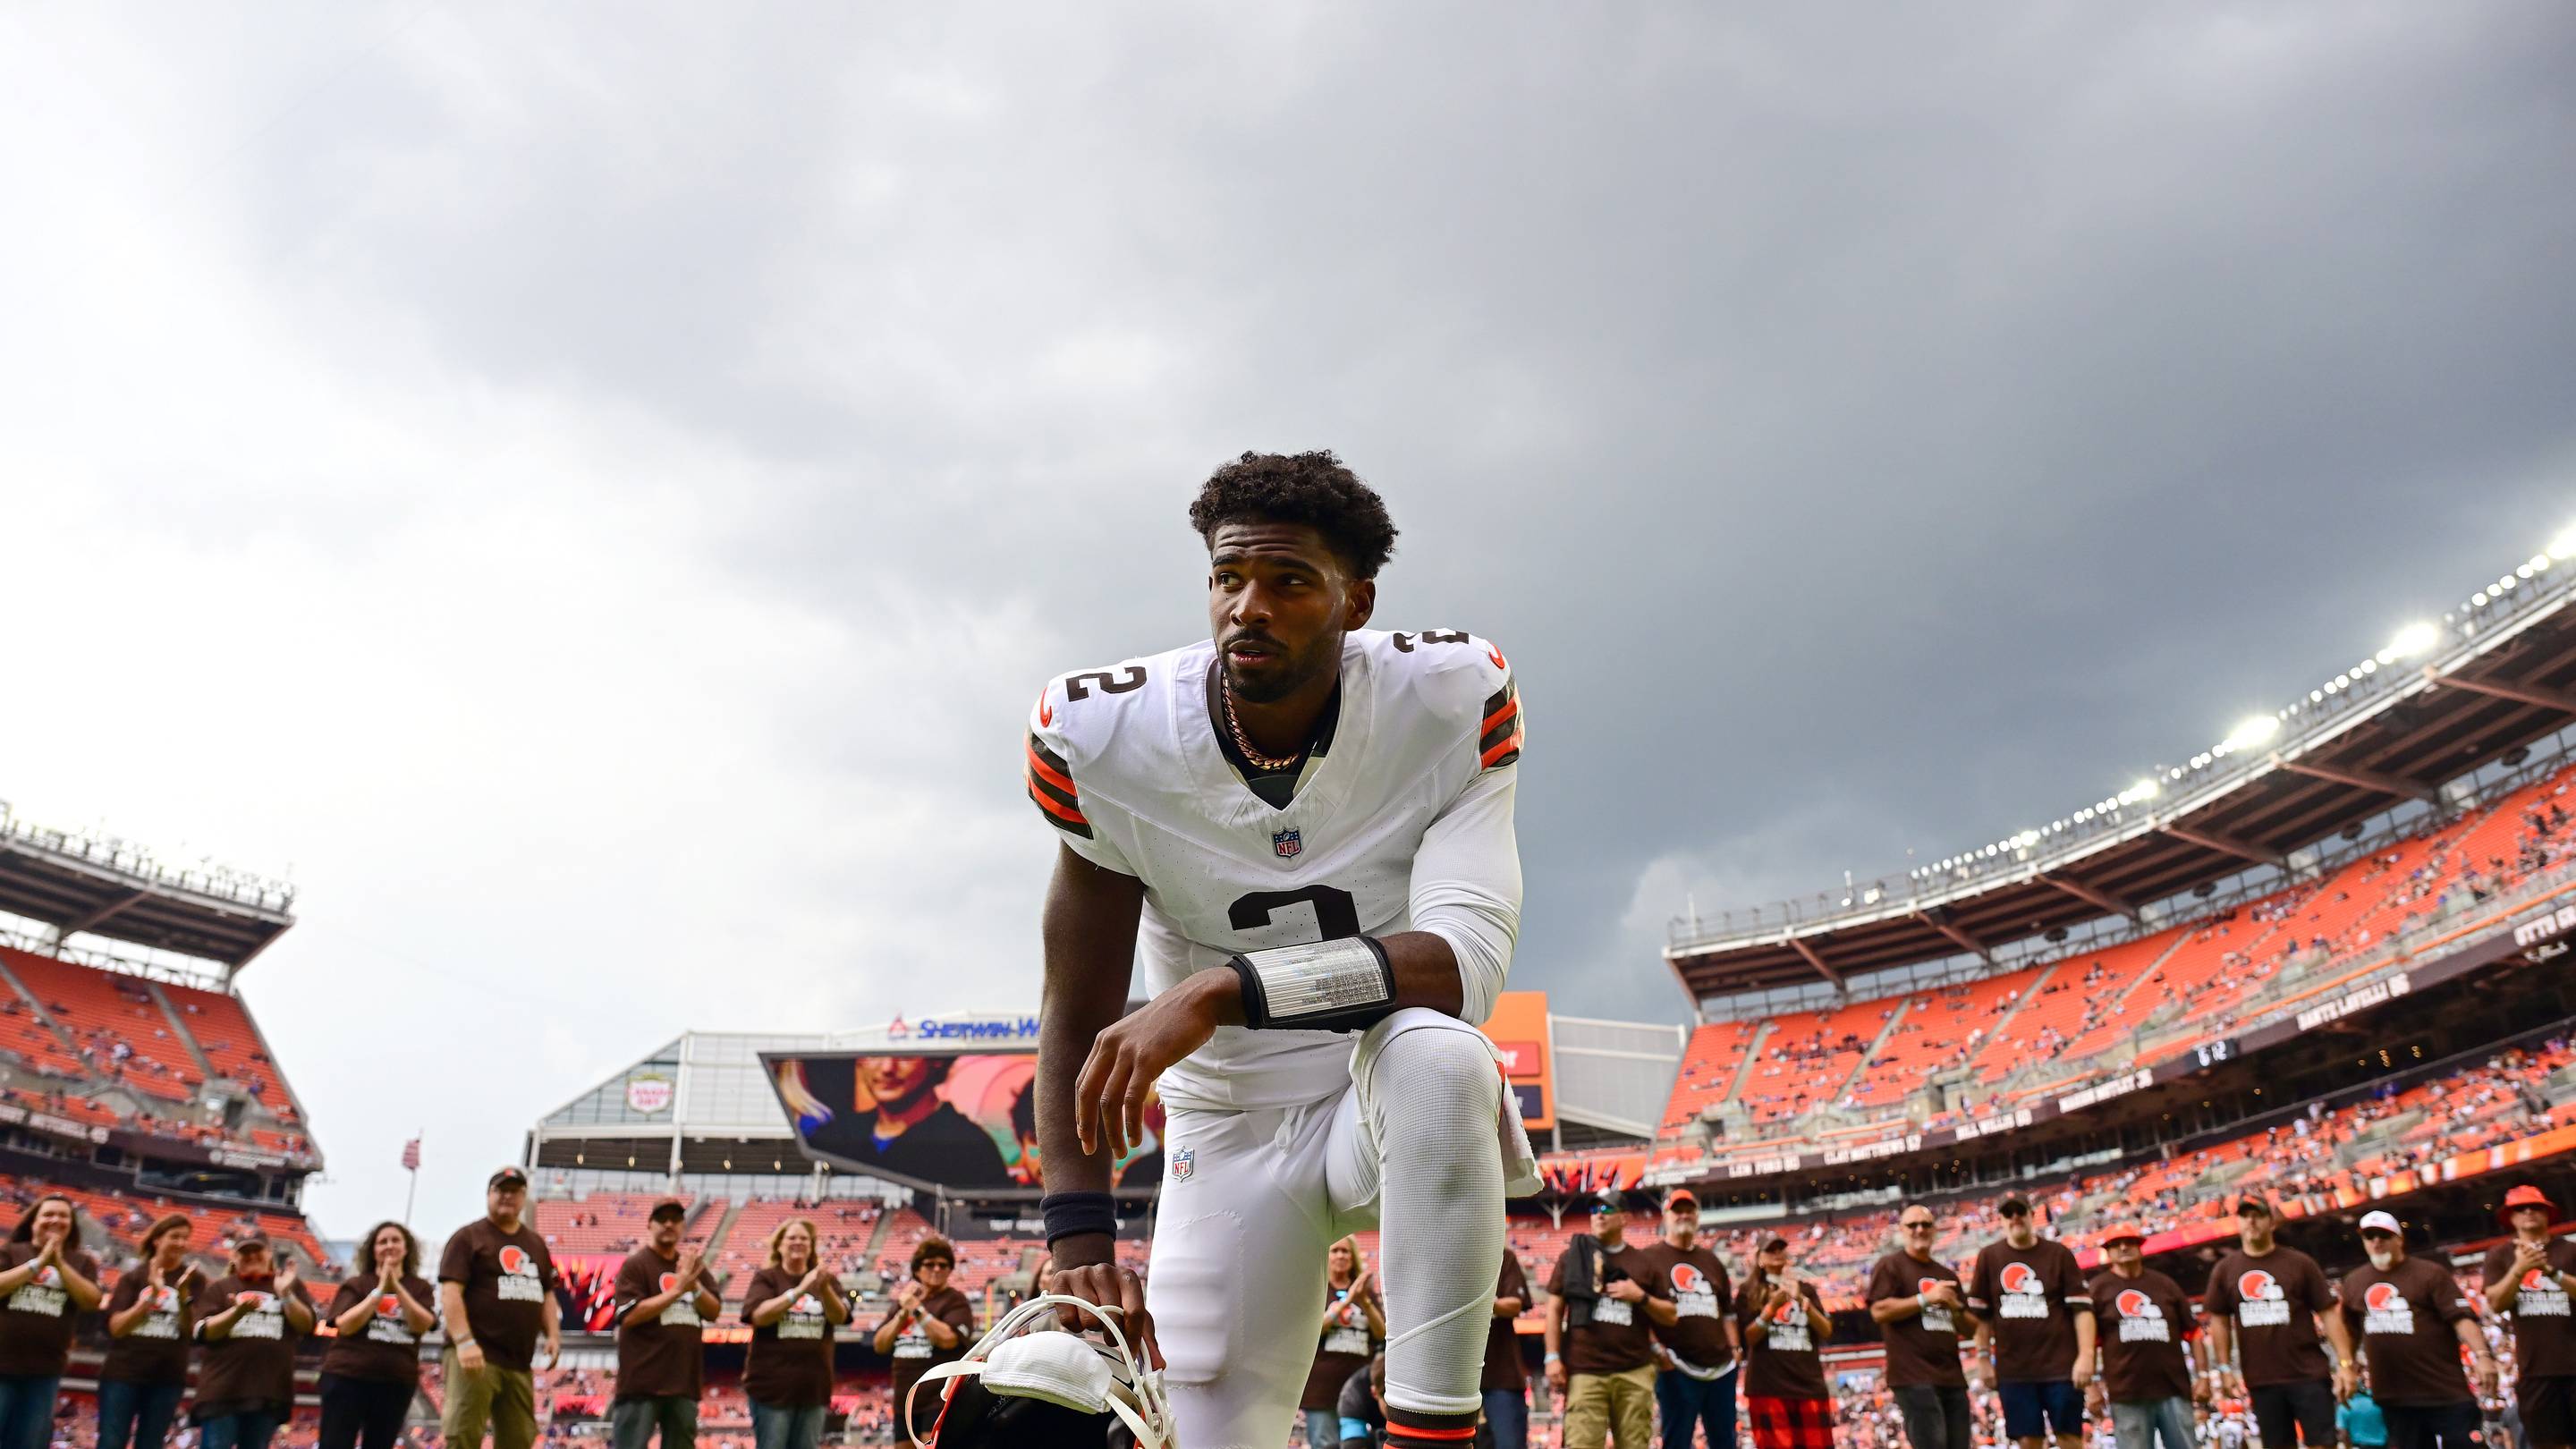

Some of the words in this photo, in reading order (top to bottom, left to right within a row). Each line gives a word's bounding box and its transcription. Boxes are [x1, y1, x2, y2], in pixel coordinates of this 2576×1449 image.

[1065, 665, 1147, 702] 2
[1277, 840, 1300, 855] NFL
[1174, 1162, 1188, 1174] NFL
